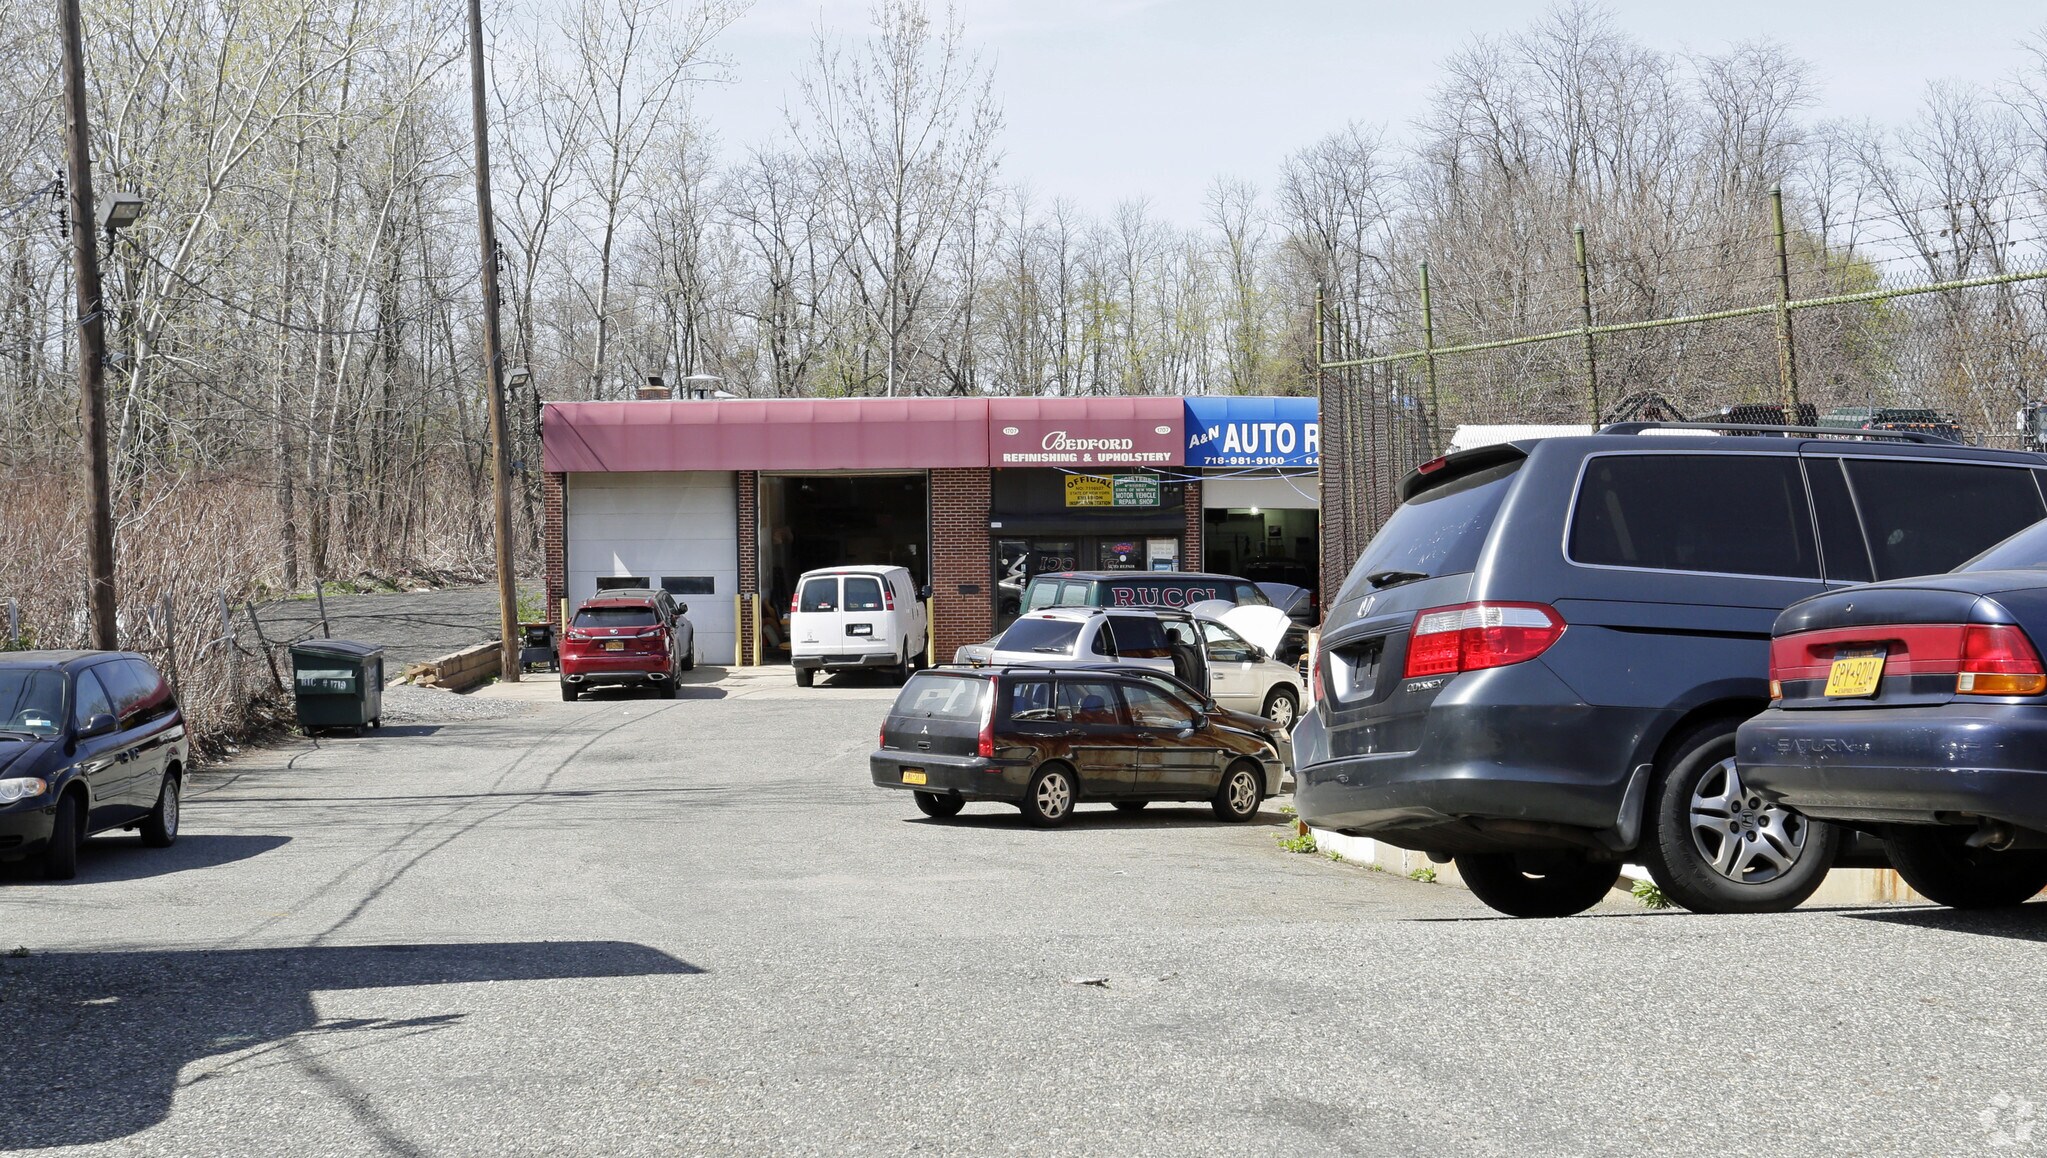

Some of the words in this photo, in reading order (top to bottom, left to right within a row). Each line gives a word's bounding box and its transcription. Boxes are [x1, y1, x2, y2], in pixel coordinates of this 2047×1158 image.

[1189, 425, 1219, 449] A&N
[1223, 422, 1296, 454] AUTO
[1003, 453, 1077, 462] REFINISHING
[1083, 453, 1092, 462] &
[1098, 452, 1171, 462] UPHOLSTERY
[1204, 457, 1284, 465] 718-981-9100
[1067, 476, 1112, 489] OFFICIAL
[1112, 587, 1216, 607] RUCCI
[1778, 738, 1855, 752] SATURN
